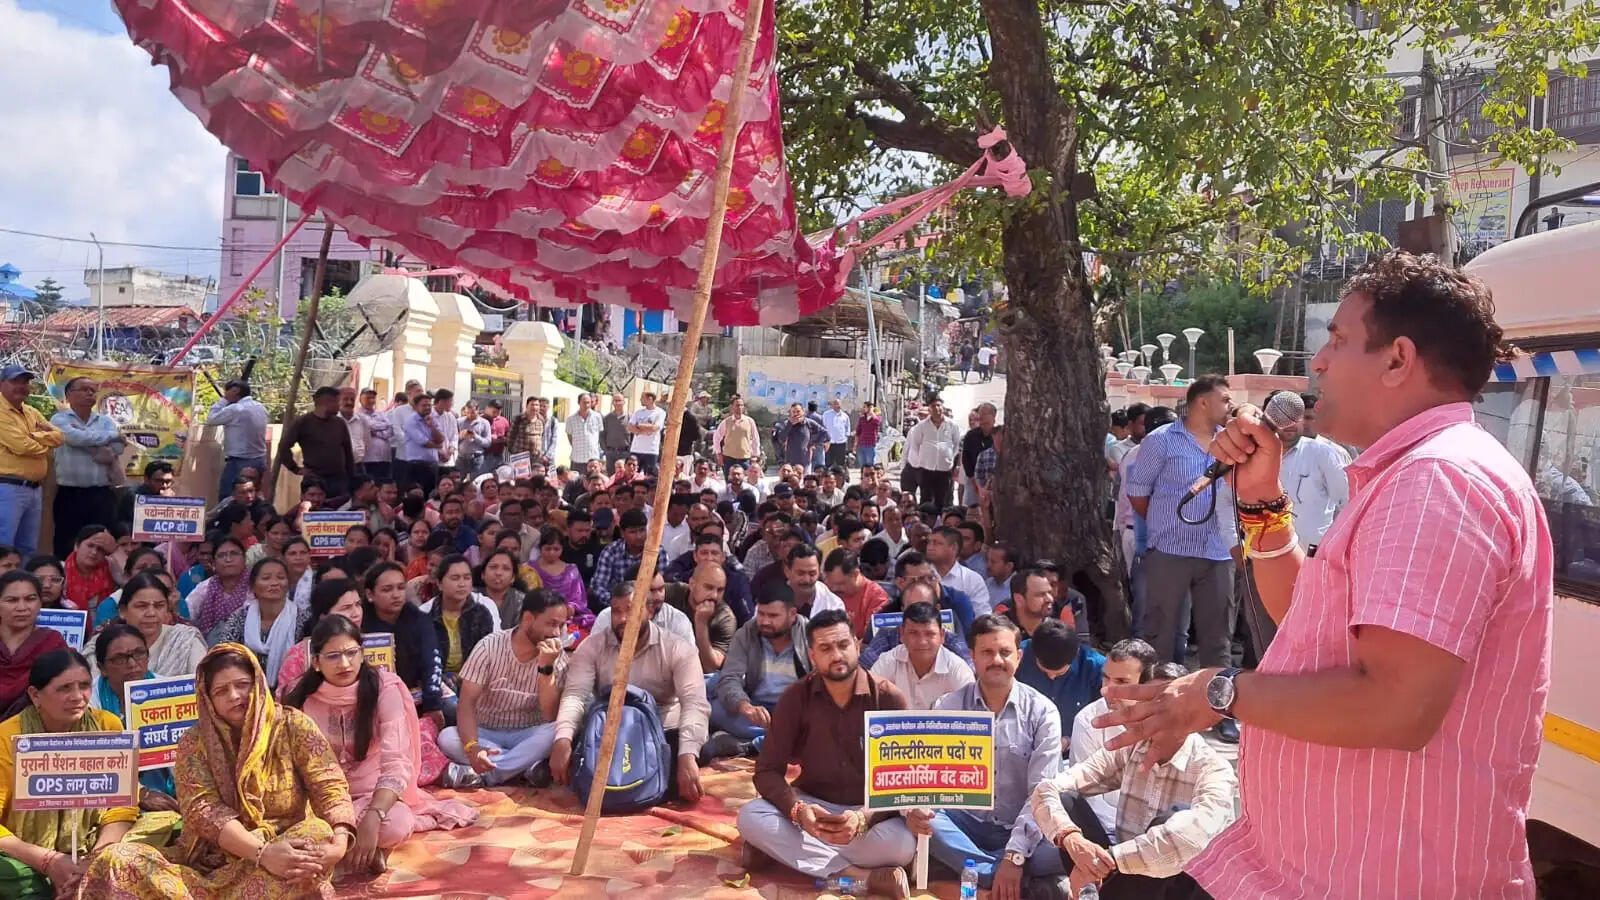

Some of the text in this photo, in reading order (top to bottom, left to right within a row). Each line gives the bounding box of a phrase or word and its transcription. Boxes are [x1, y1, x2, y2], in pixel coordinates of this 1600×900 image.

[1471, 178, 1510, 190] Restaurant
[154, 522, 174, 531] ACP
[314, 537, 329, 545] OPS
[70, 633, 78, 643] का
[141, 702, 198, 724] एकता हमा
[143, 725, 168, 744] संघर्ष
[879, 740, 982, 761] मिनिस्टीरियल पदों पर
[21, 752, 128, 776] पुरानी पेंशन बहाल करो!
[36, 776, 113, 794] OPS लागू करो!
[875, 765, 984, 787] आउटसोर्सिंग बंद करो!
